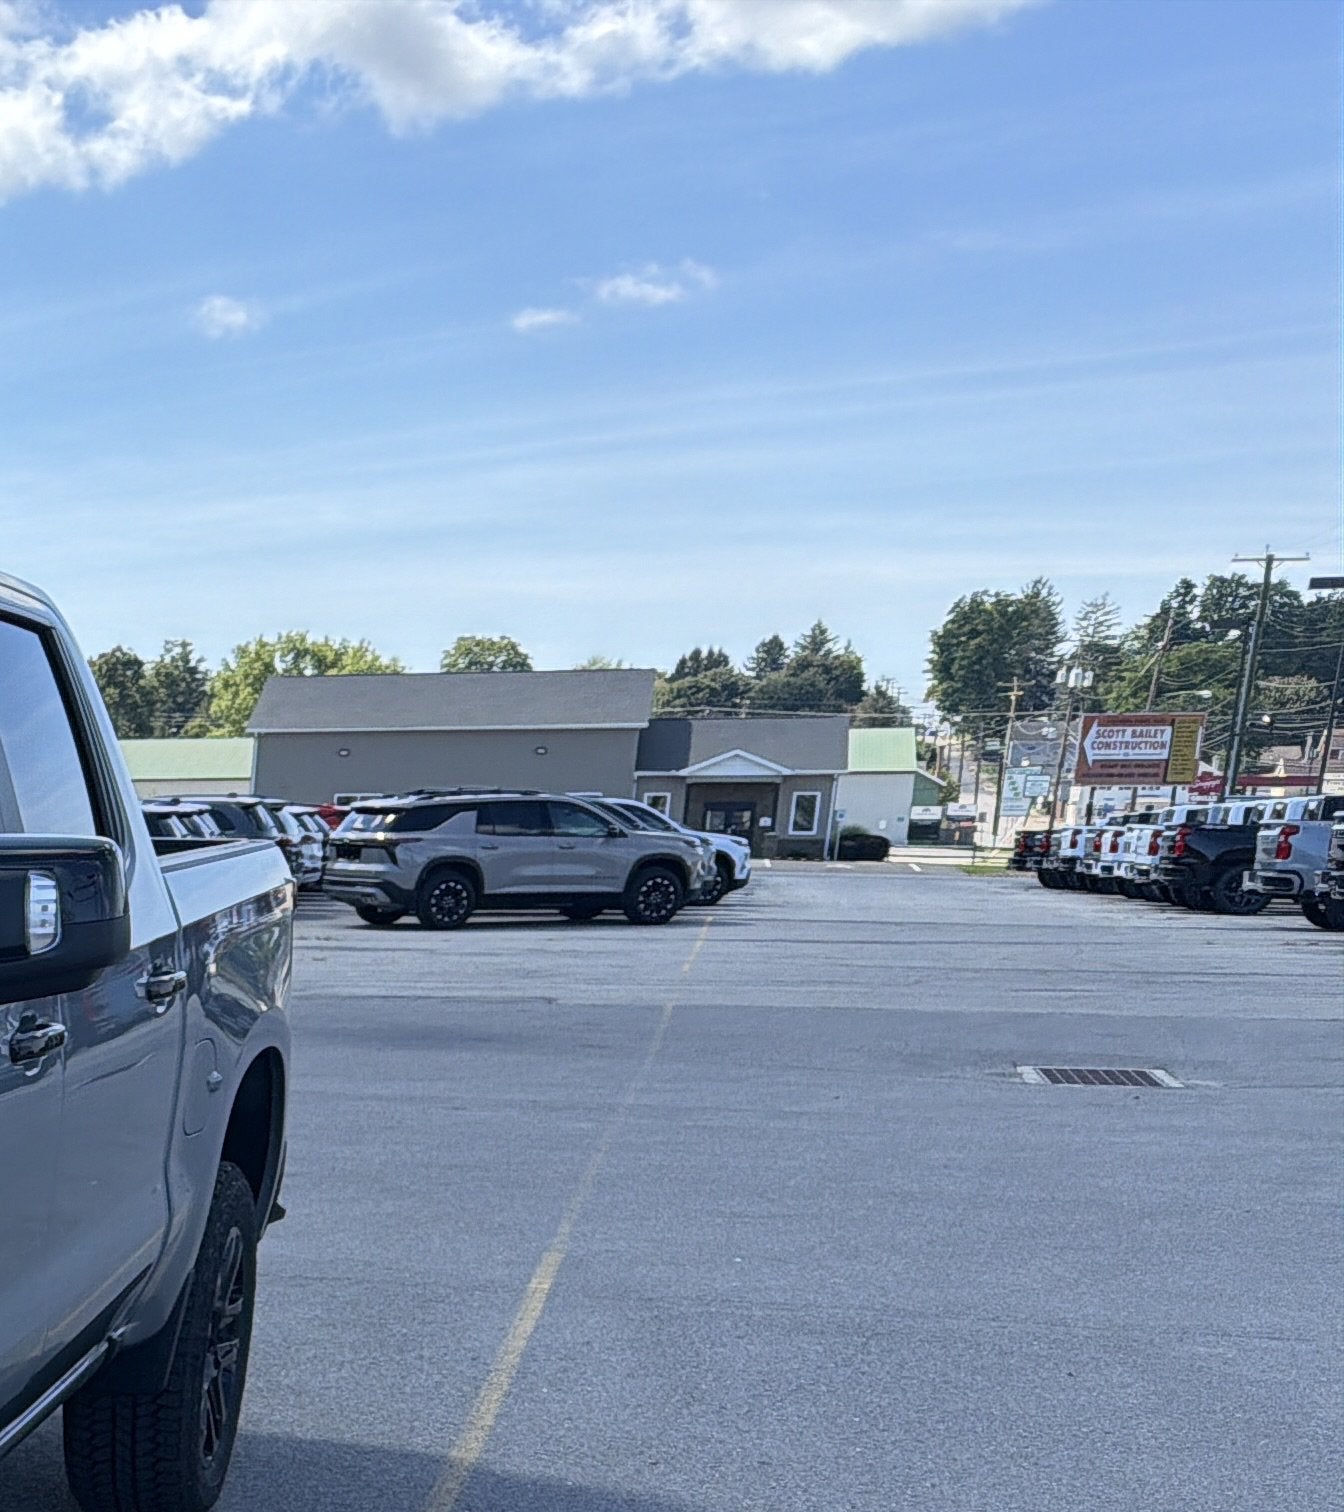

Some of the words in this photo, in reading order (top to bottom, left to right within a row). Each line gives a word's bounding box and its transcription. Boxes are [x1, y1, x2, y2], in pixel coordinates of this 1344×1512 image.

[1095, 728, 1127, 739] SCOTT
[1131, 728, 1167, 739] BAILEY
[1091, 740, 1168, 750] CONSTRUCTION
